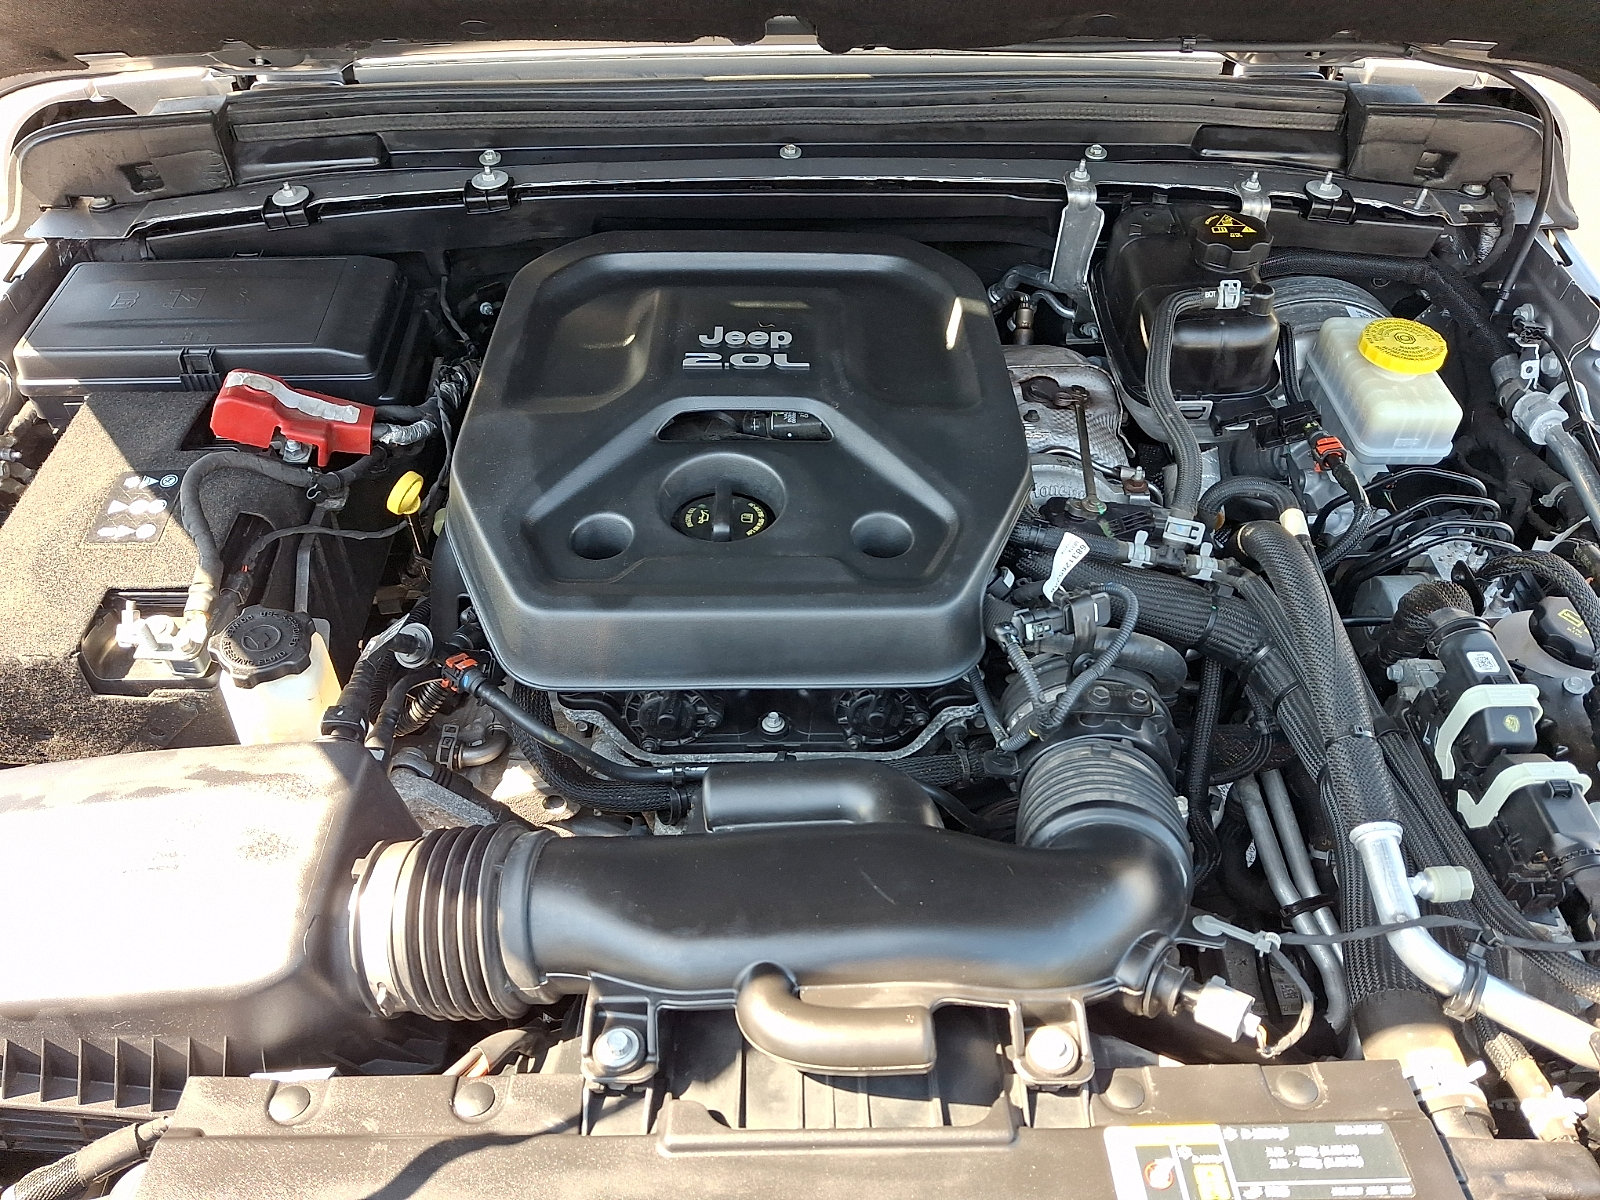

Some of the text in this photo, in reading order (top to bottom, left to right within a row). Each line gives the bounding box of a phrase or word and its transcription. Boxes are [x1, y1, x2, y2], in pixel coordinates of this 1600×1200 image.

[698, 325, 793, 350] Jeep
[682, 352, 811, 370] 2.0L
[223, 614, 287, 666] POWER STEERING FLUID
[281, 614, 301, 648] APPROVED
